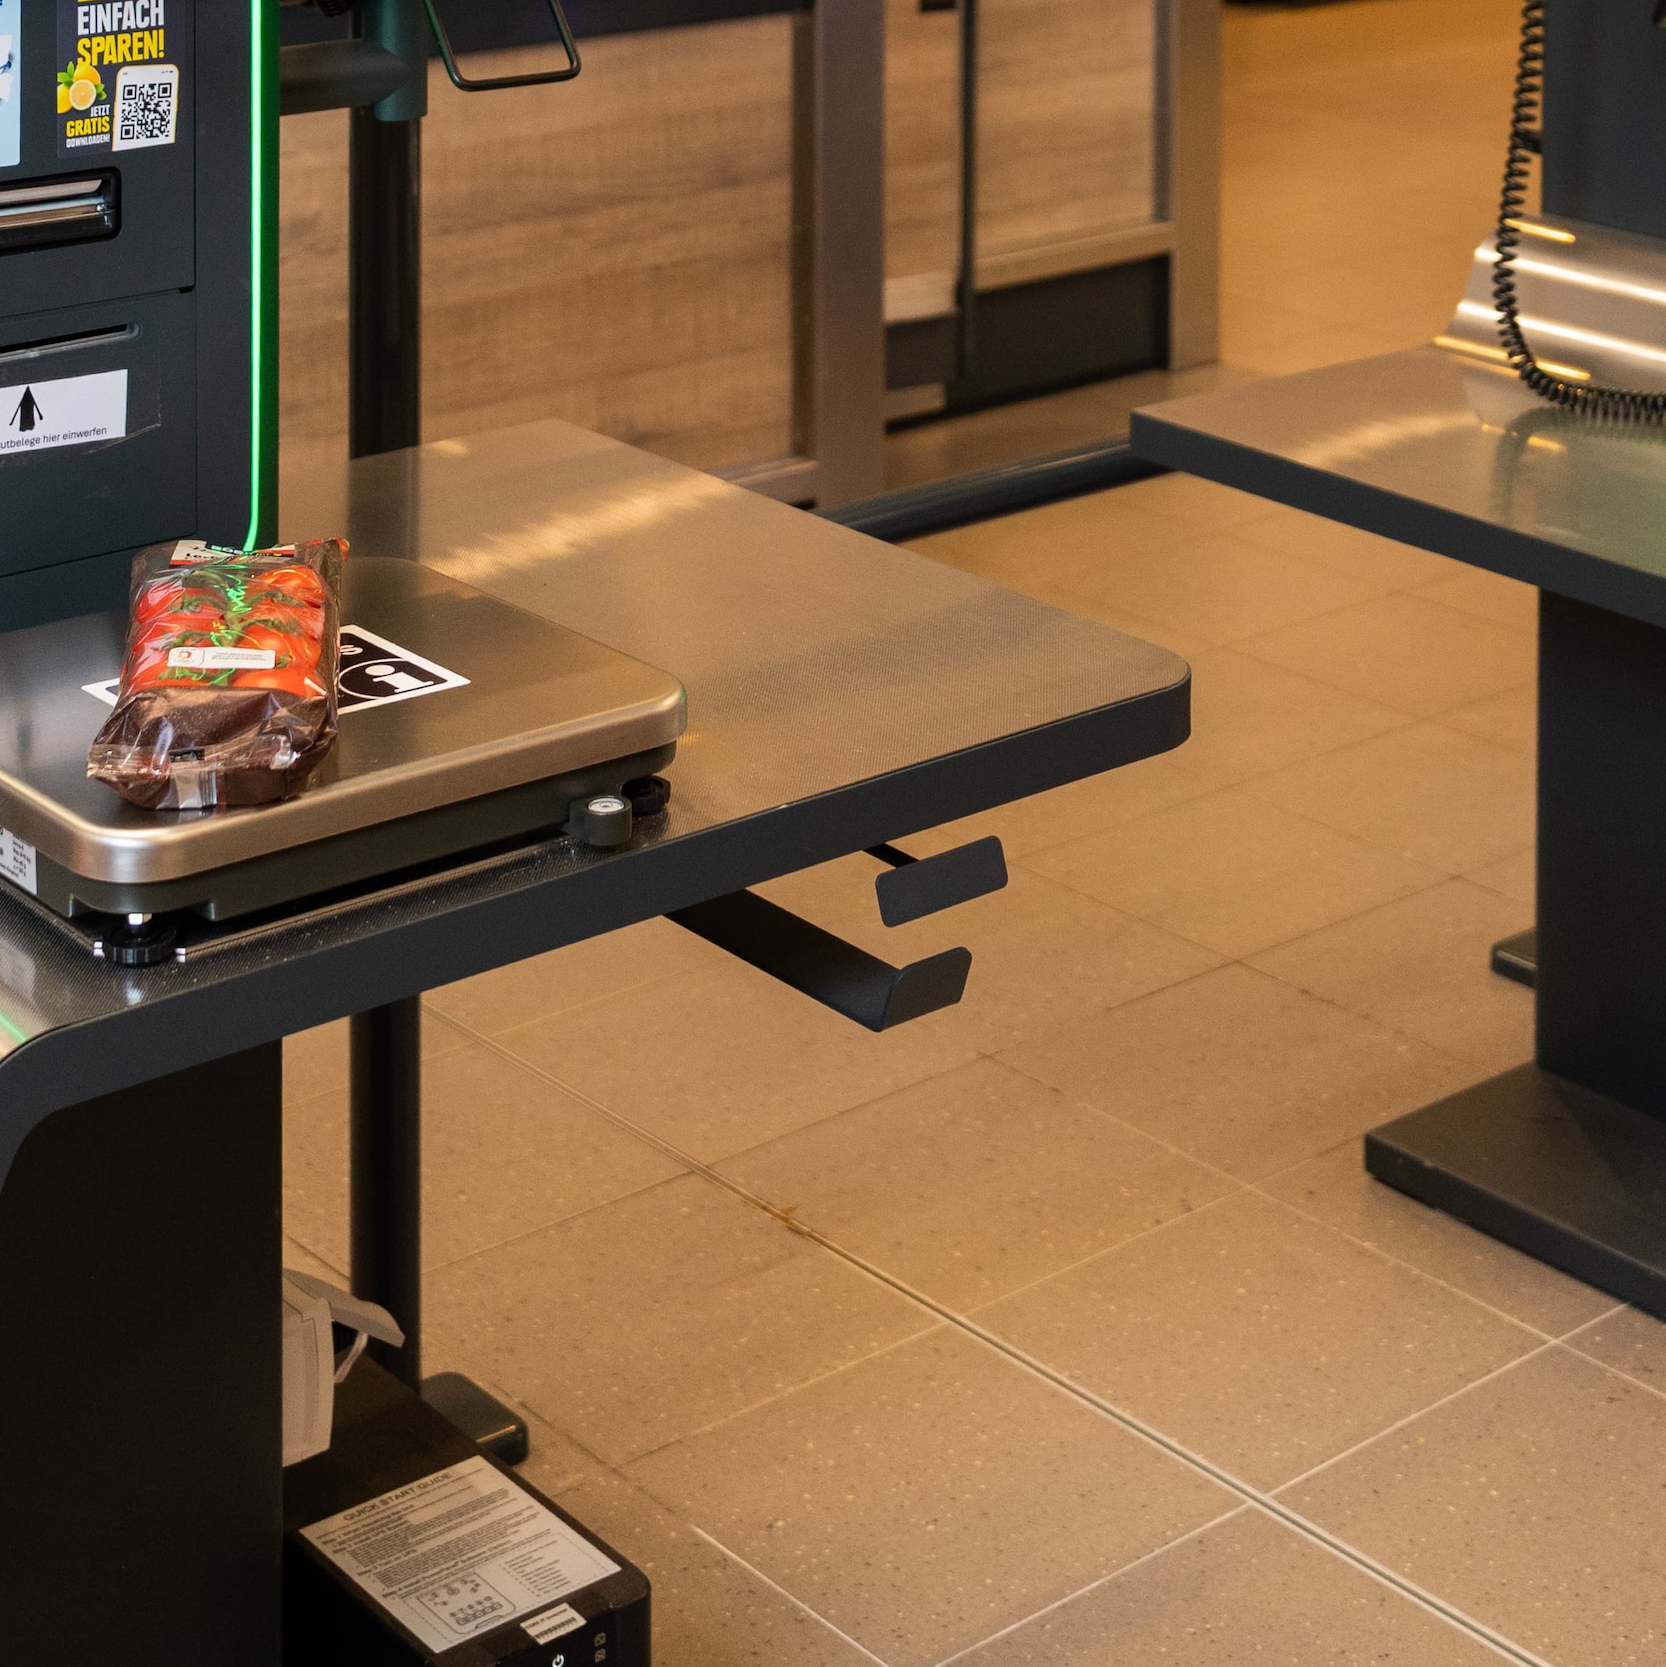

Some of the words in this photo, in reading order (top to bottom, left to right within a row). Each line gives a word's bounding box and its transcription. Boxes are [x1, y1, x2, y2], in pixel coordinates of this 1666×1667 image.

[77, 28, 165, 66] SPAREN!
[90, 104, 111, 117] JETZT
[66, 116, 110, 138] GRATIS
[66, 134, 111, 148] DOWNLOADEN!
[43, 433, 60, 444] hier
[62, 427, 107, 441] einwerfen
[342, 1503, 380, 1521] QUICK
[380, 1488, 417, 1505] START
[416, 1472, 454, 1490] GUIDE
